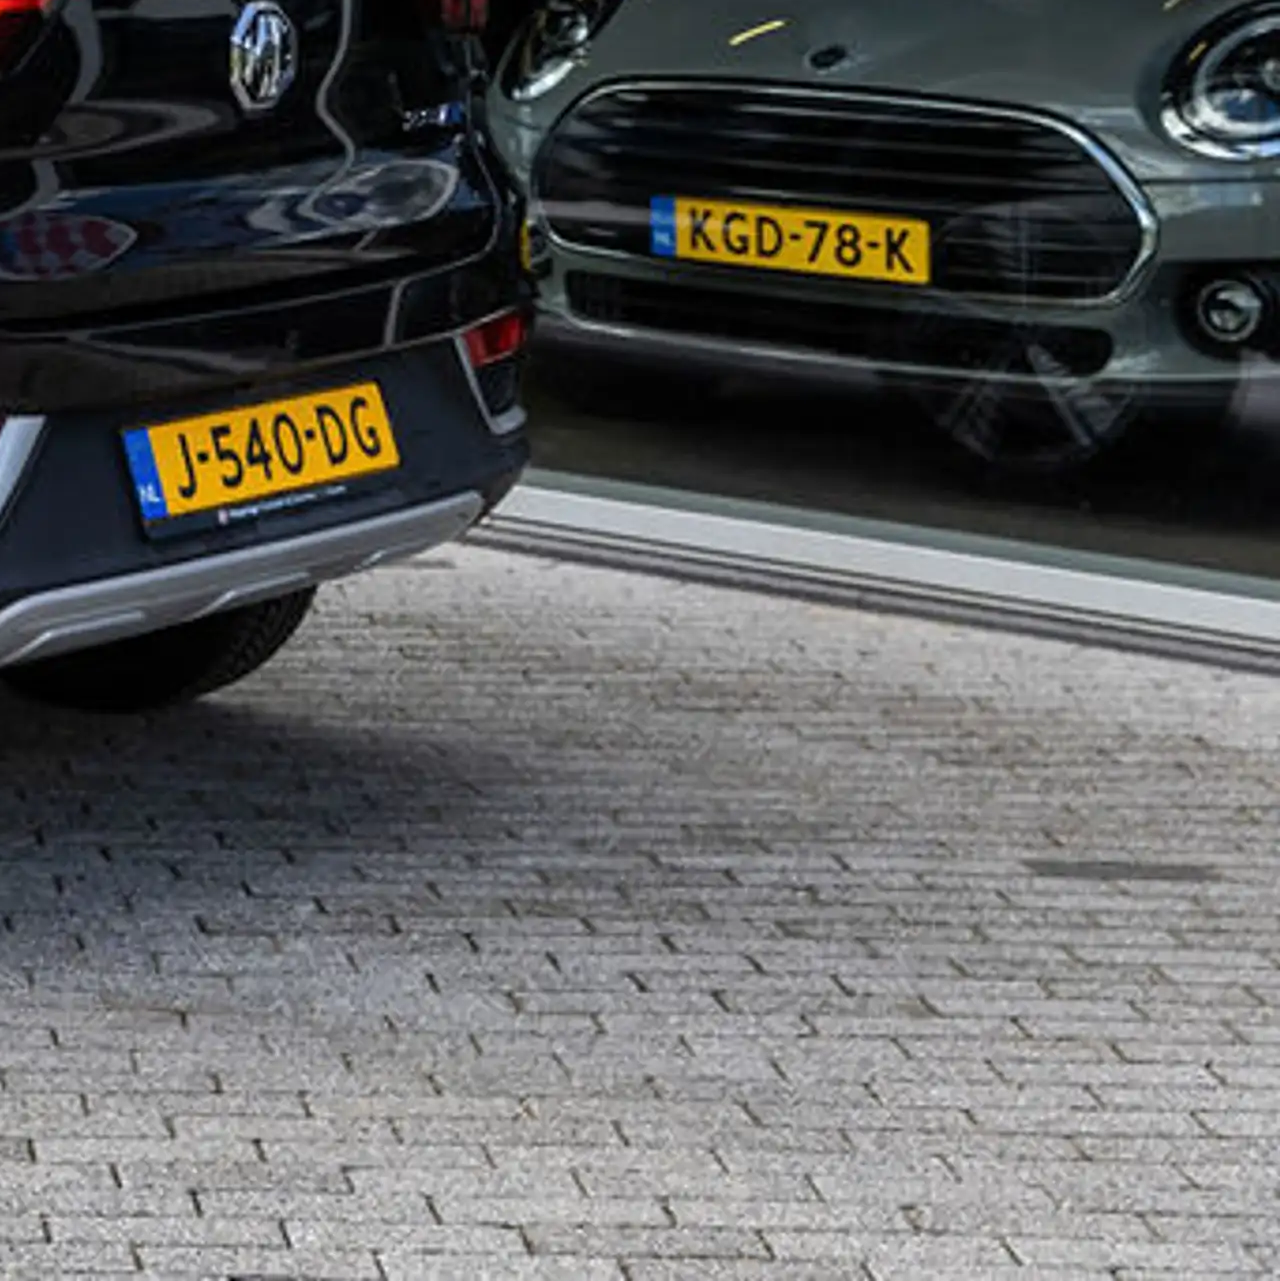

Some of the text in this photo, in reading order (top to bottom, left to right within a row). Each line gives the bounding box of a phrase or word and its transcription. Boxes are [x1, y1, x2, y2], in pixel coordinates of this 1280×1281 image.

[689, 207, 913, 274] KGD-78-K
[177, 397, 381, 499] J-540-DG
[139, 482, 161, 503] NL
